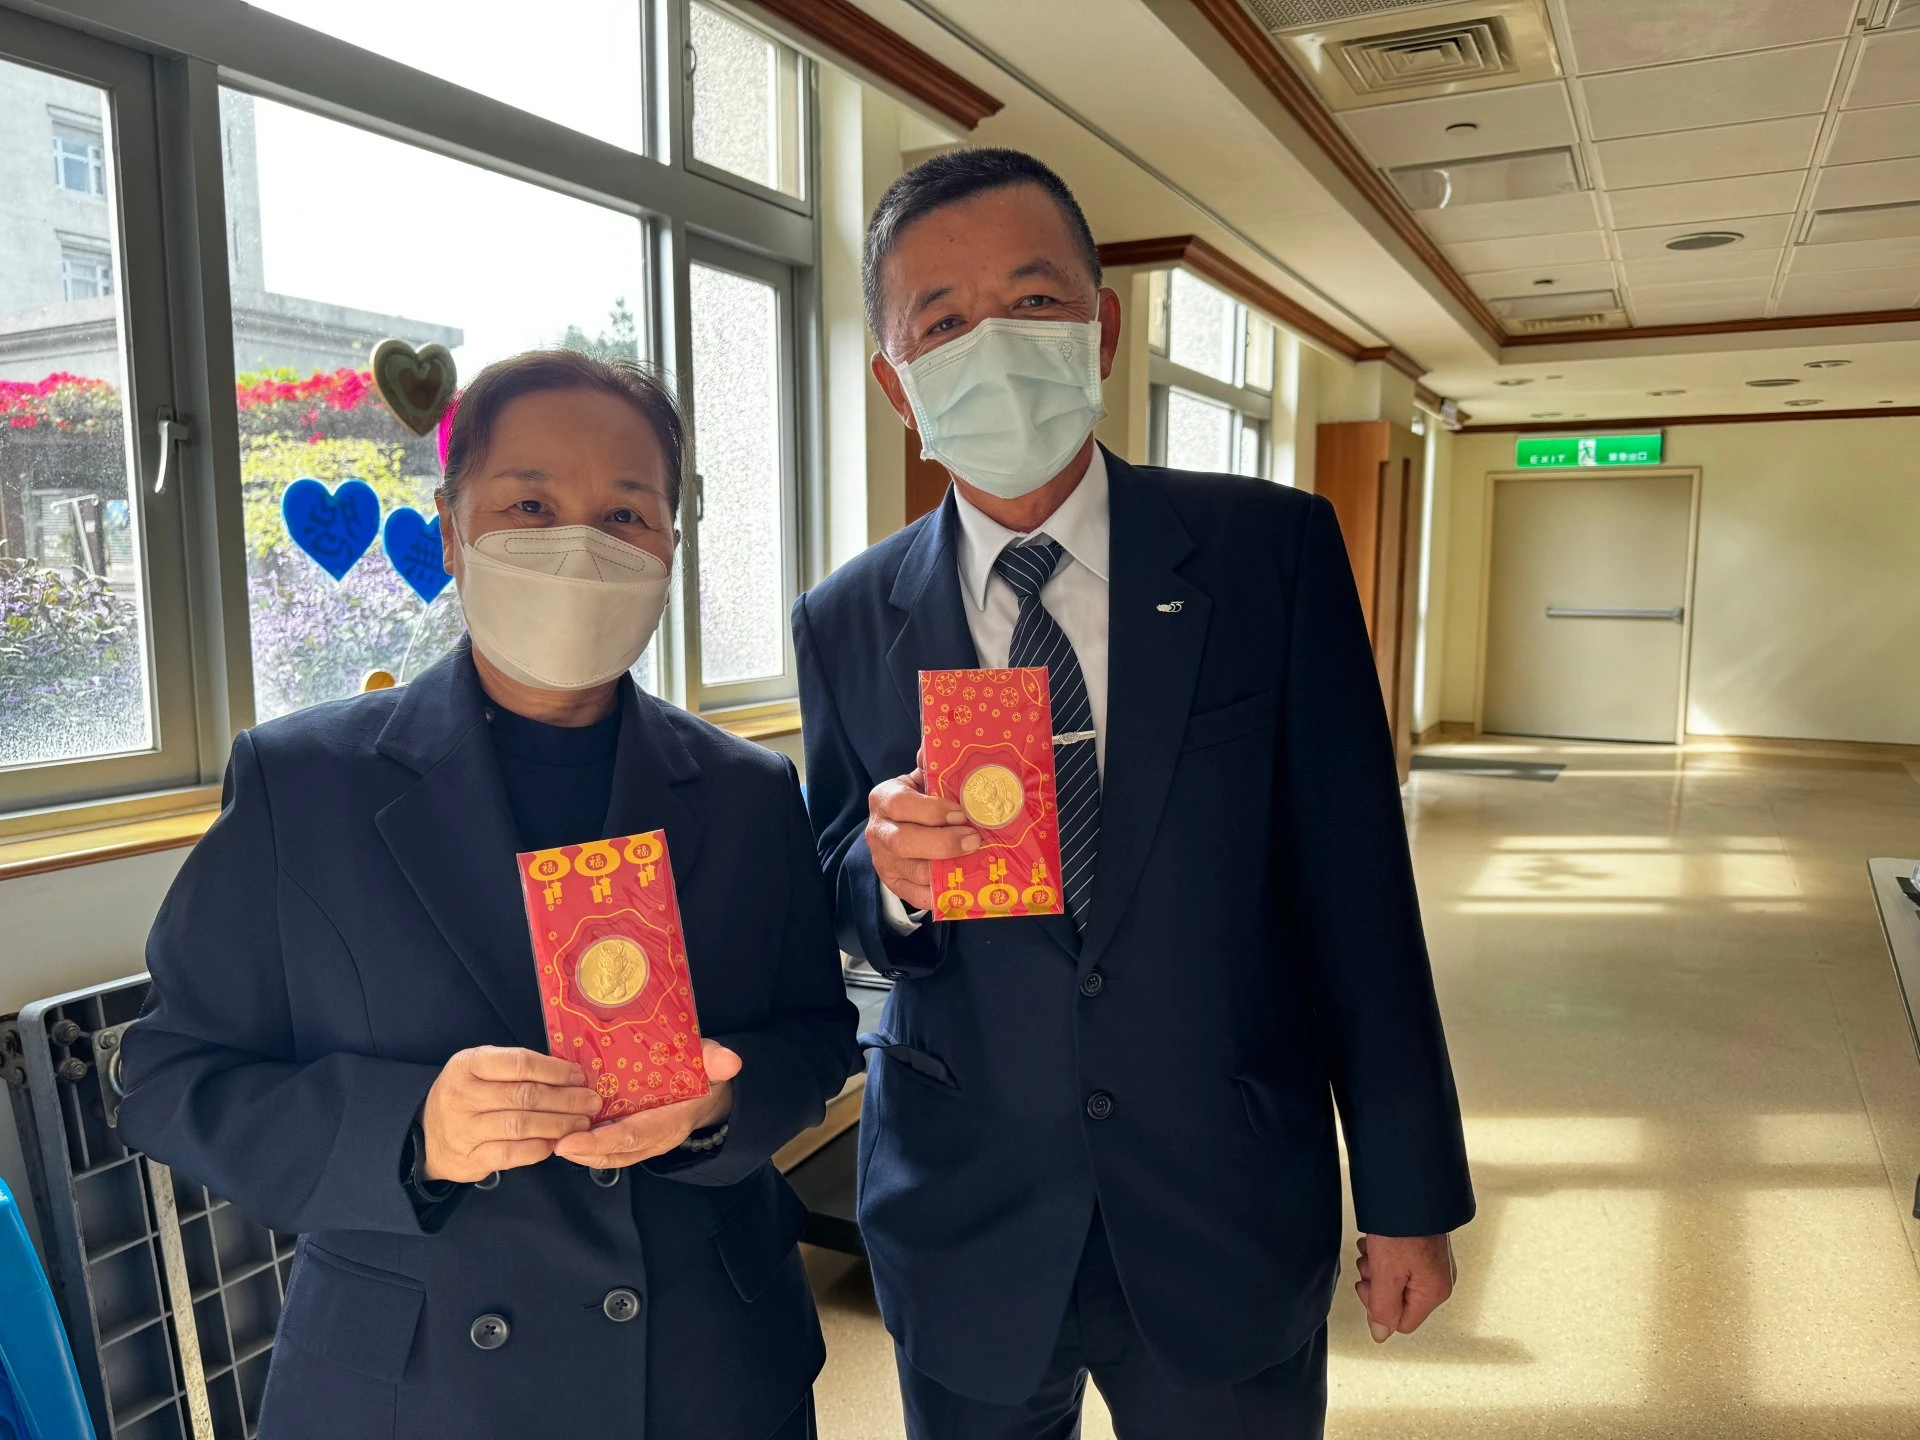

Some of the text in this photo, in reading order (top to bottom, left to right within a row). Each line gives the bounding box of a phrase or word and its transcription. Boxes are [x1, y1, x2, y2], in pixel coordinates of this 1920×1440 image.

[1529, 454, 1566, 464] EXIT
[541, 844, 649, 874] 福 福 福
[951, 890, 1046, 907] 福 福 福
